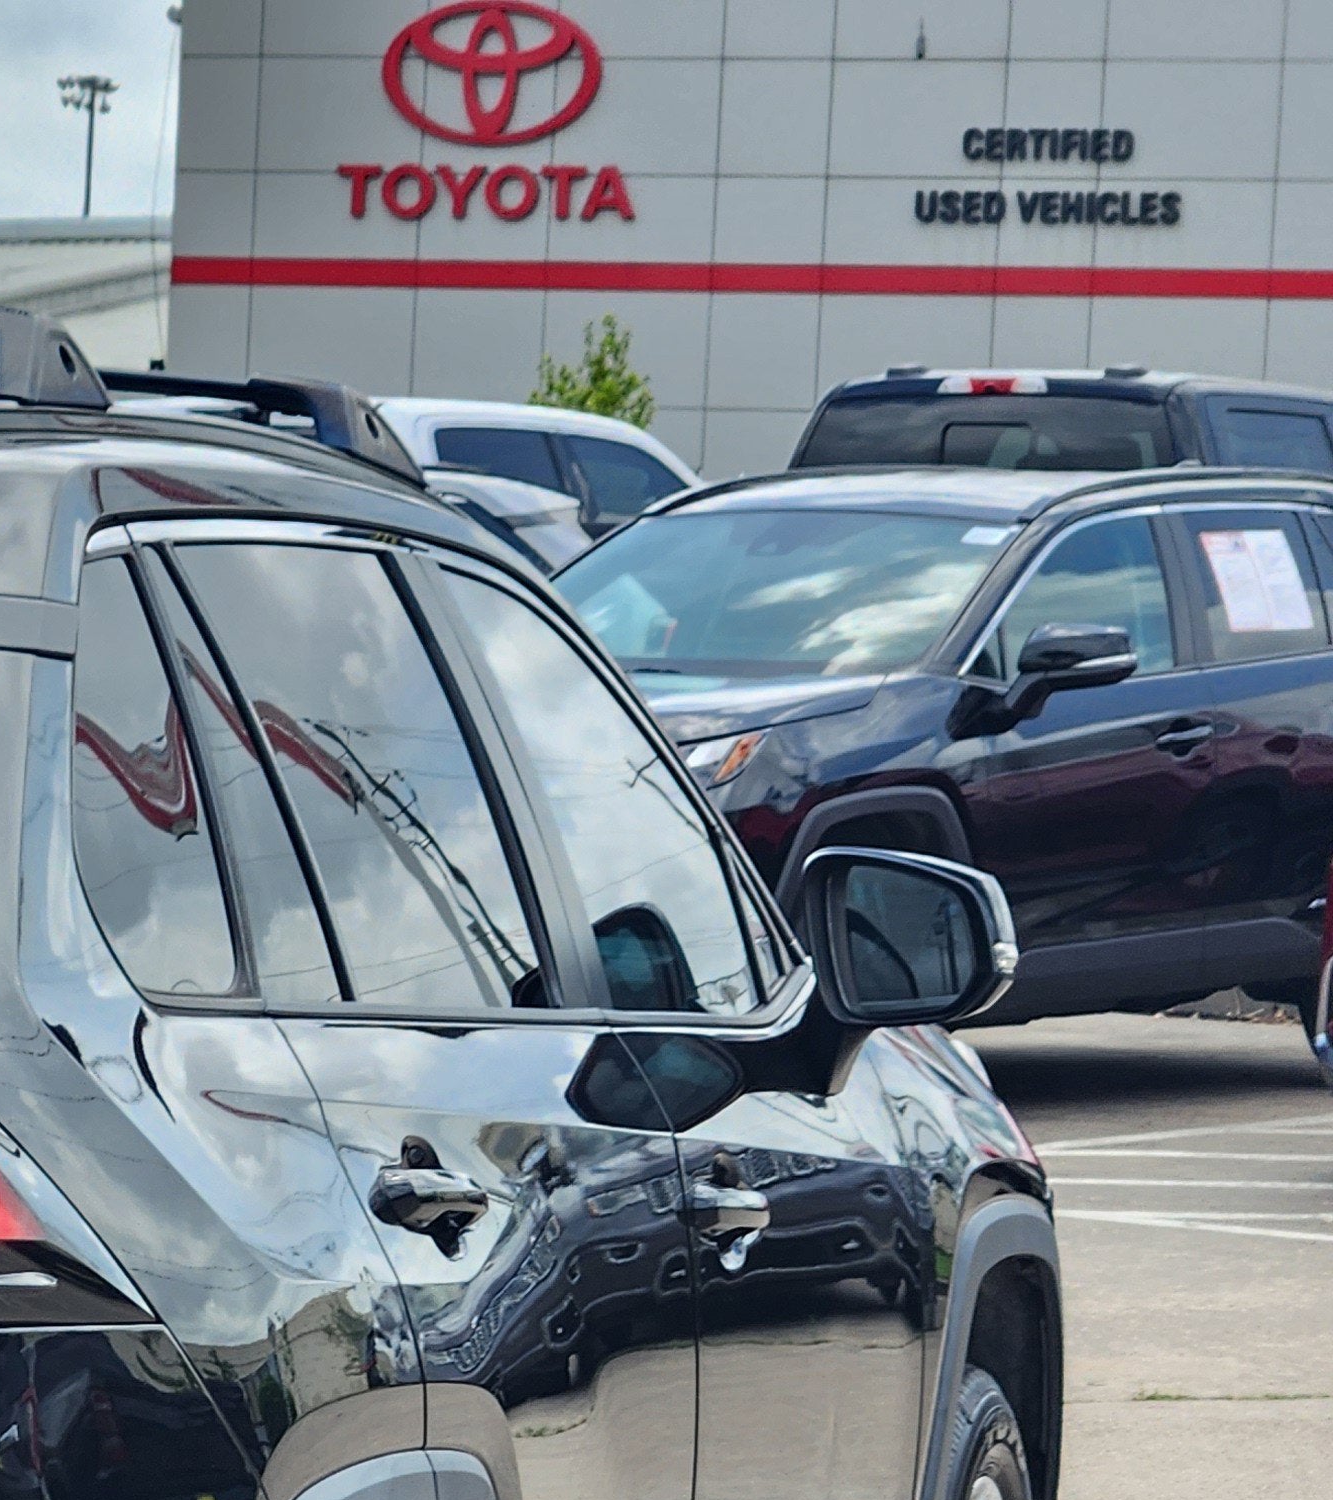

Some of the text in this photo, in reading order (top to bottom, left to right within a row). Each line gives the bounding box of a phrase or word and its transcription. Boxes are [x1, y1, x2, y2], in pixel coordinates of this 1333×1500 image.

[962, 128, 1135, 163] CERTIFIED
[336, 163, 635, 221] TOYOTA
[914, 190, 1182, 227] USED VEHICLES
